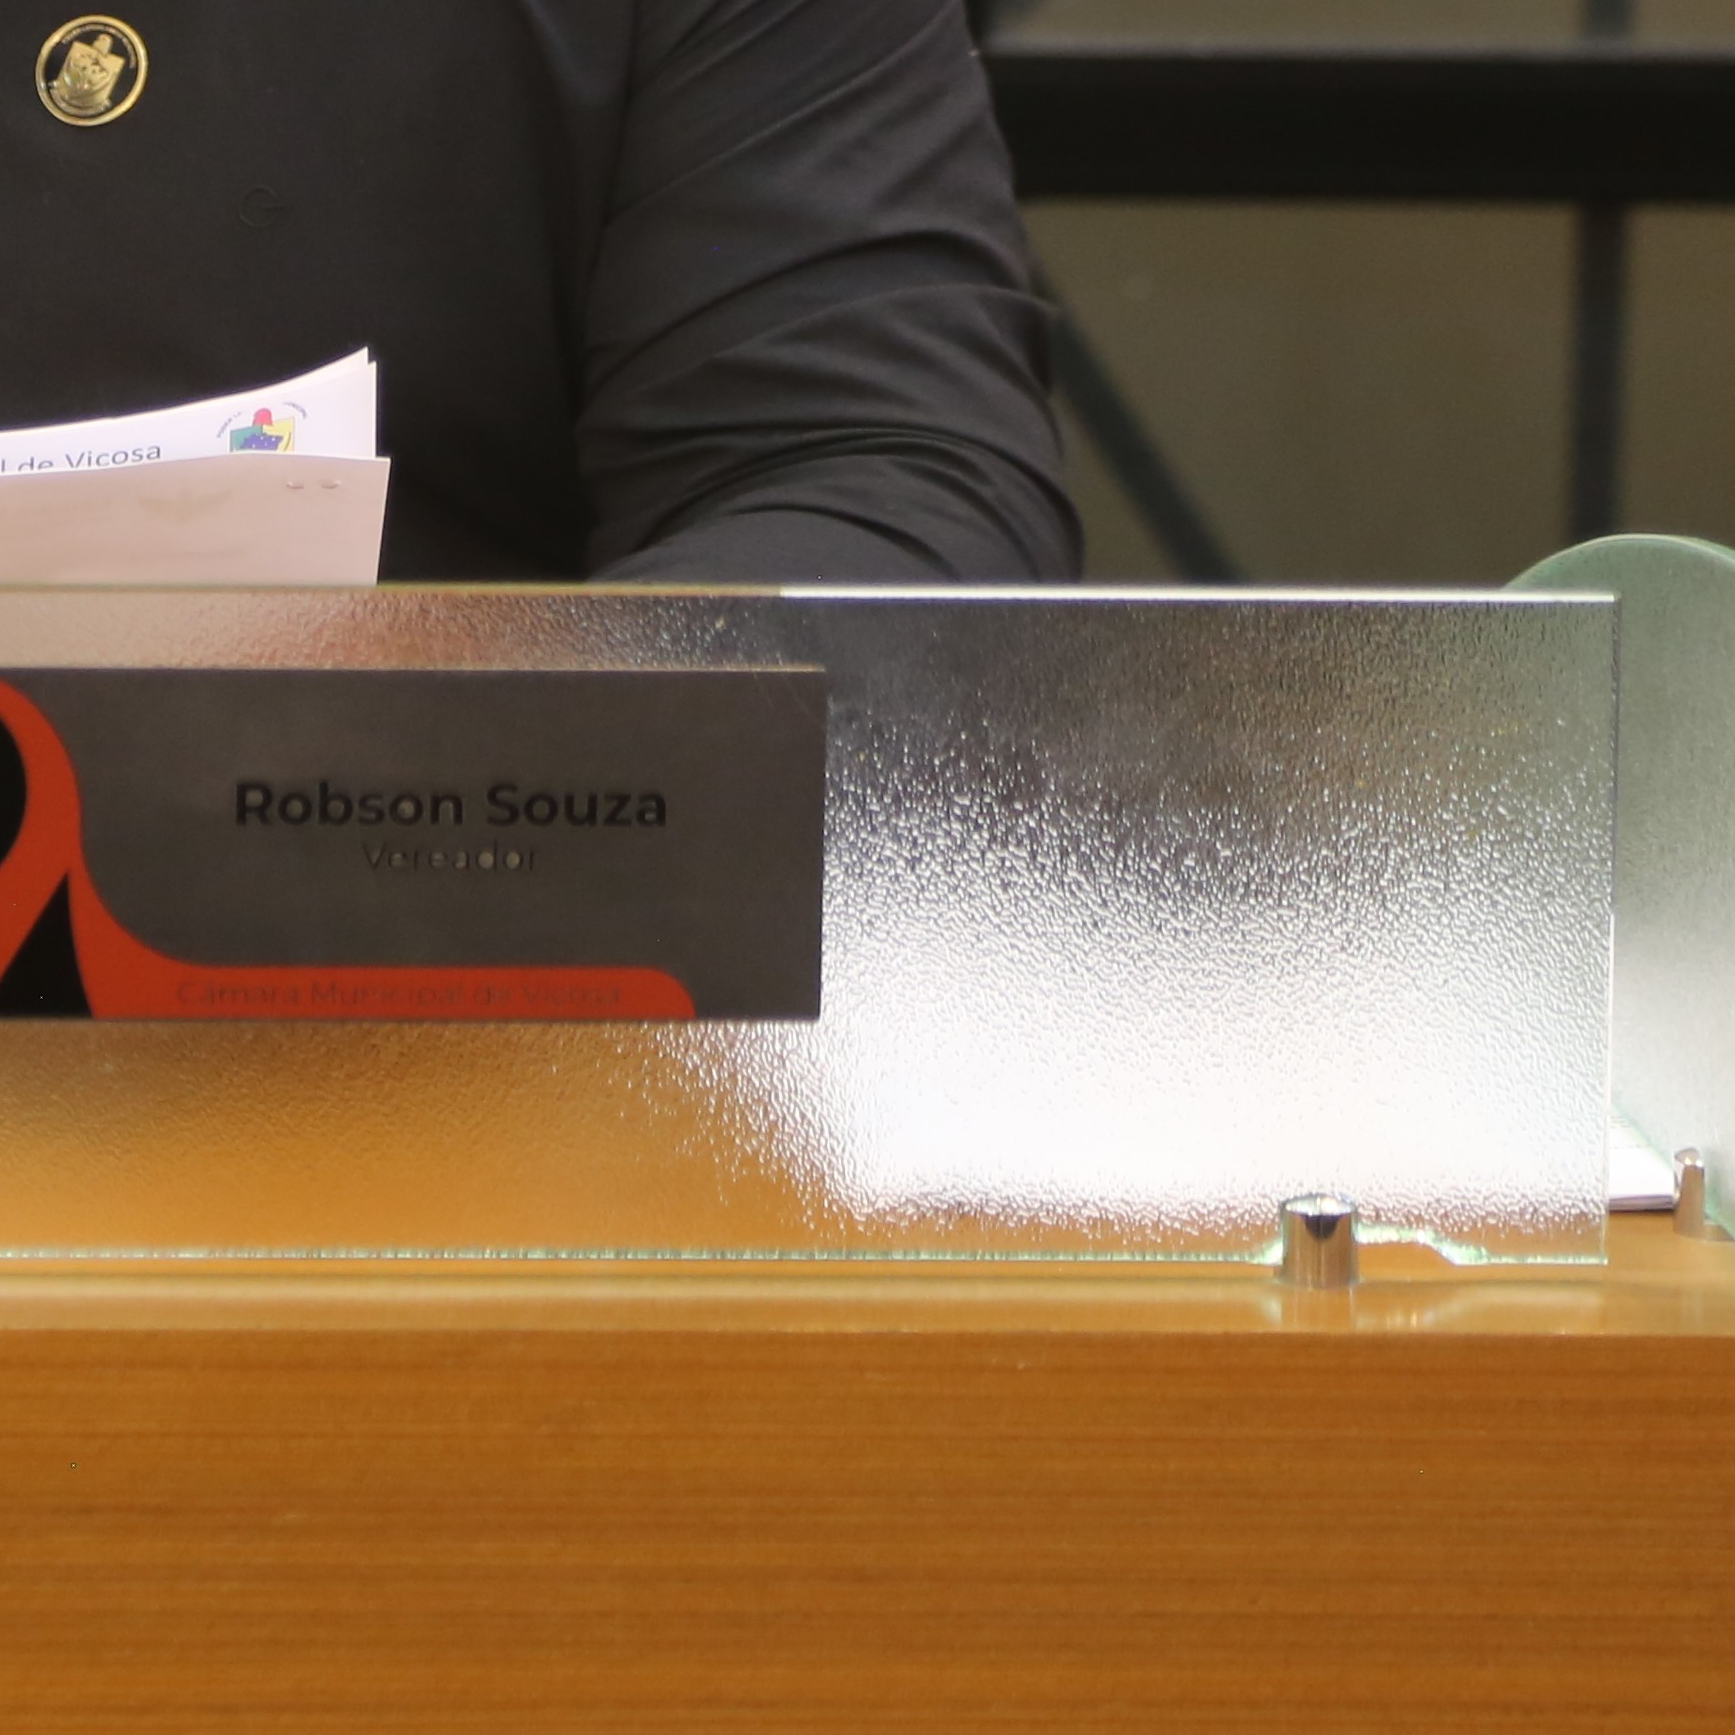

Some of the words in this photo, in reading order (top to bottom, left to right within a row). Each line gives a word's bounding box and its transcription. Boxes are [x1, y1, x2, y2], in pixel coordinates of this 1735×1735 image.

[235, 781, 464, 827] Robson
[486, 782, 667, 827] Souza
[362, 840, 537, 872] Vereador
